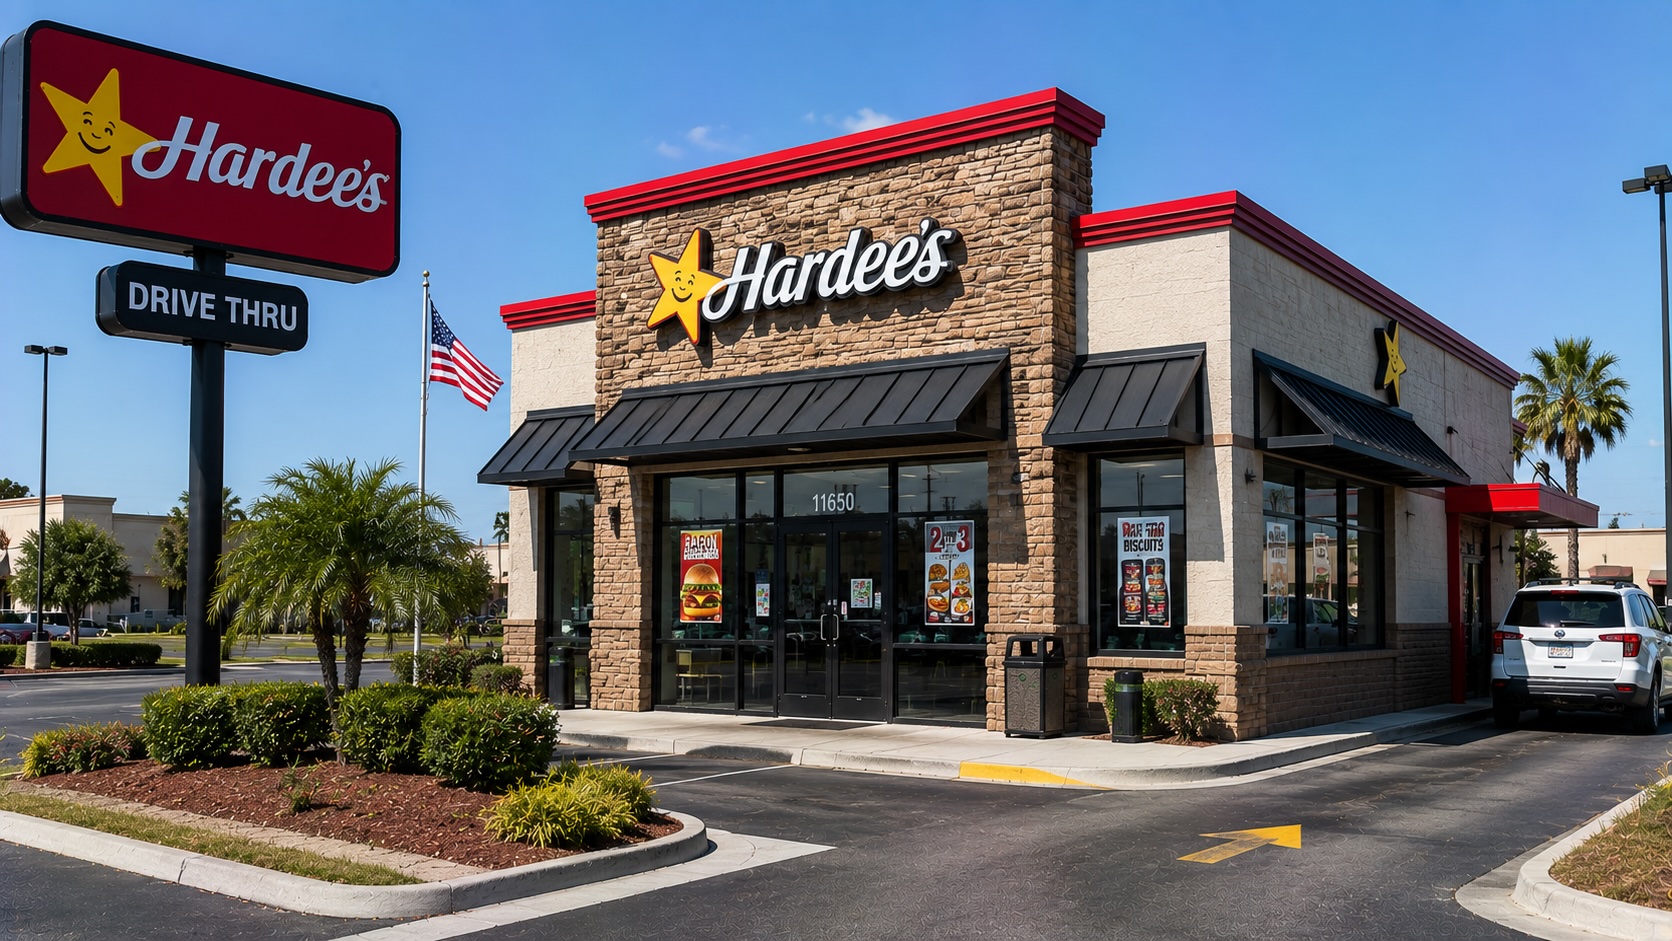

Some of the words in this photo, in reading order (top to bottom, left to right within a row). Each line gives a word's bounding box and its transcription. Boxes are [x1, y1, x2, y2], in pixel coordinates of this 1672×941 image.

[131, 115, 388, 213] Hardee's
[701, 218, 953, 321] Hardee's
[129, 282, 216, 321] DRIVE
[225, 296, 298, 332] THRU
[812, 492, 855, 512] 11650
[930, 526, 943, 553] 2
[956, 524, 970, 553] 3
[1123, 538, 1164, 553] BISCUITS
